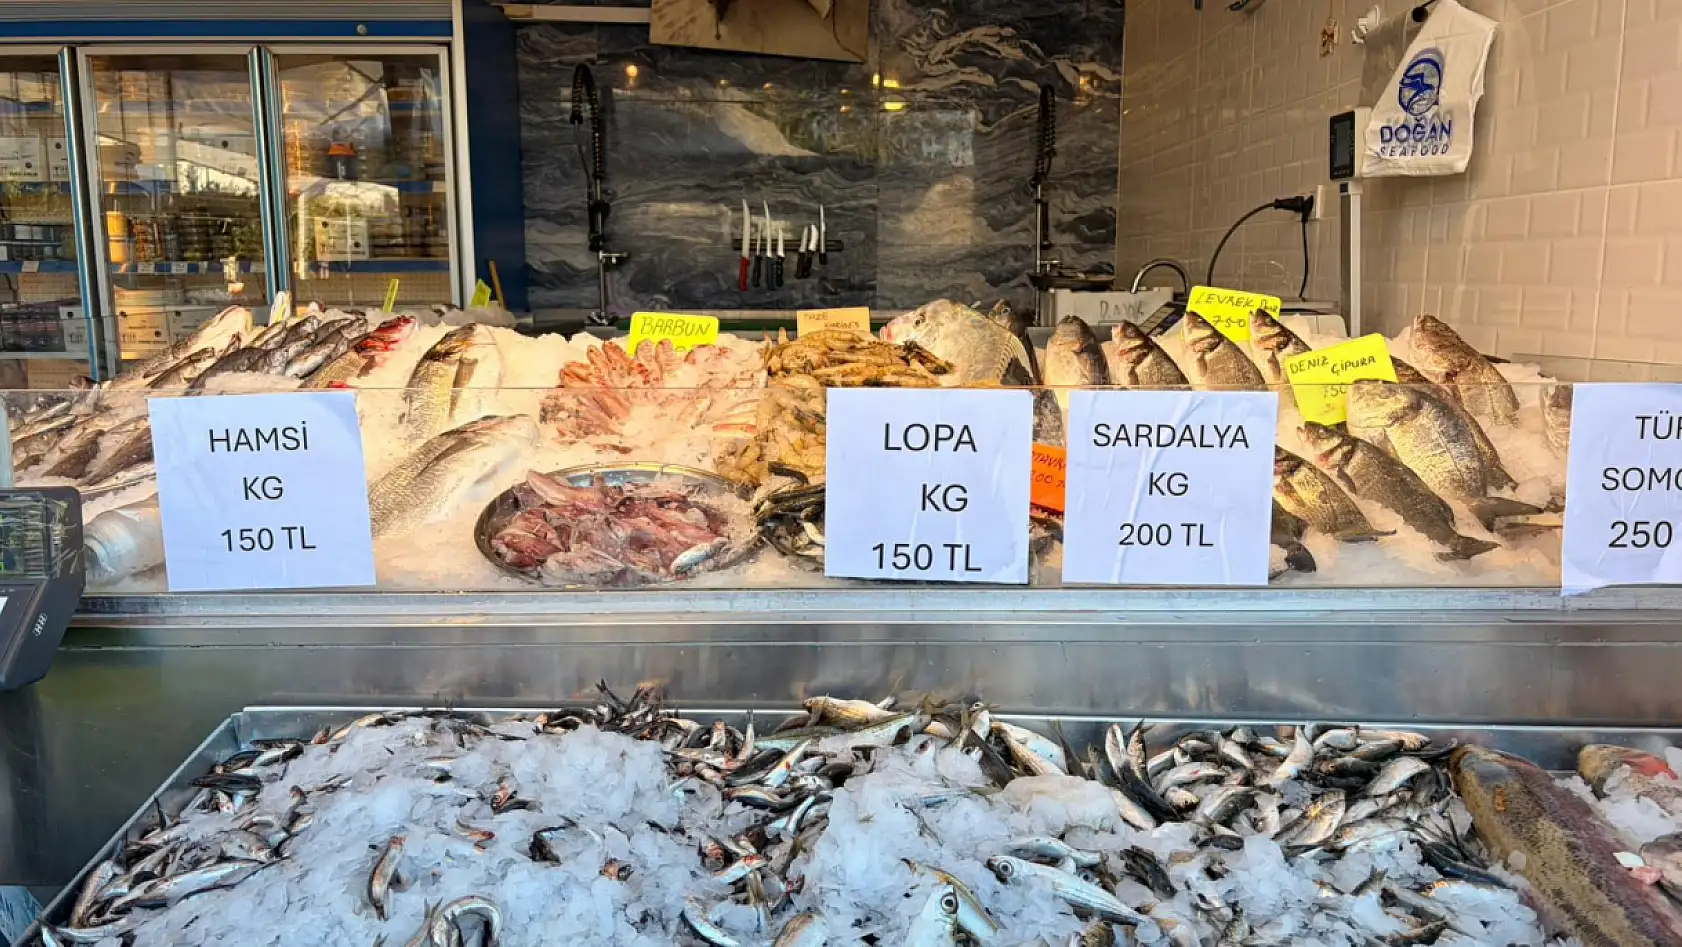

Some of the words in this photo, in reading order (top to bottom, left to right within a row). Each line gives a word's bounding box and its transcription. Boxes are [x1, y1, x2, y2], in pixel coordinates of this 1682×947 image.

[1380, 117, 1453, 143] DOĞAN
[1379, 144, 1450, 157] SEAFOOD
[640, 316, 711, 337] BARBUN
[209, 420, 308, 453] HAMSİ
[884, 423, 978, 453] LOPA
[1093, 423, 1250, 449] SARDALYA
[243, 475, 283, 501] KG
[1148, 471, 1189, 497] KG
[921, 483, 968, 513] KG
[221, 528, 274, 552] 150
[281, 526, 317, 550] TL
[1118, 522, 1172, 546] 200
[1180, 522, 1214, 547] TL
[1608, 521, 1673, 549] 250
[872, 543, 933, 571] 150
[942, 543, 982, 572] TL
